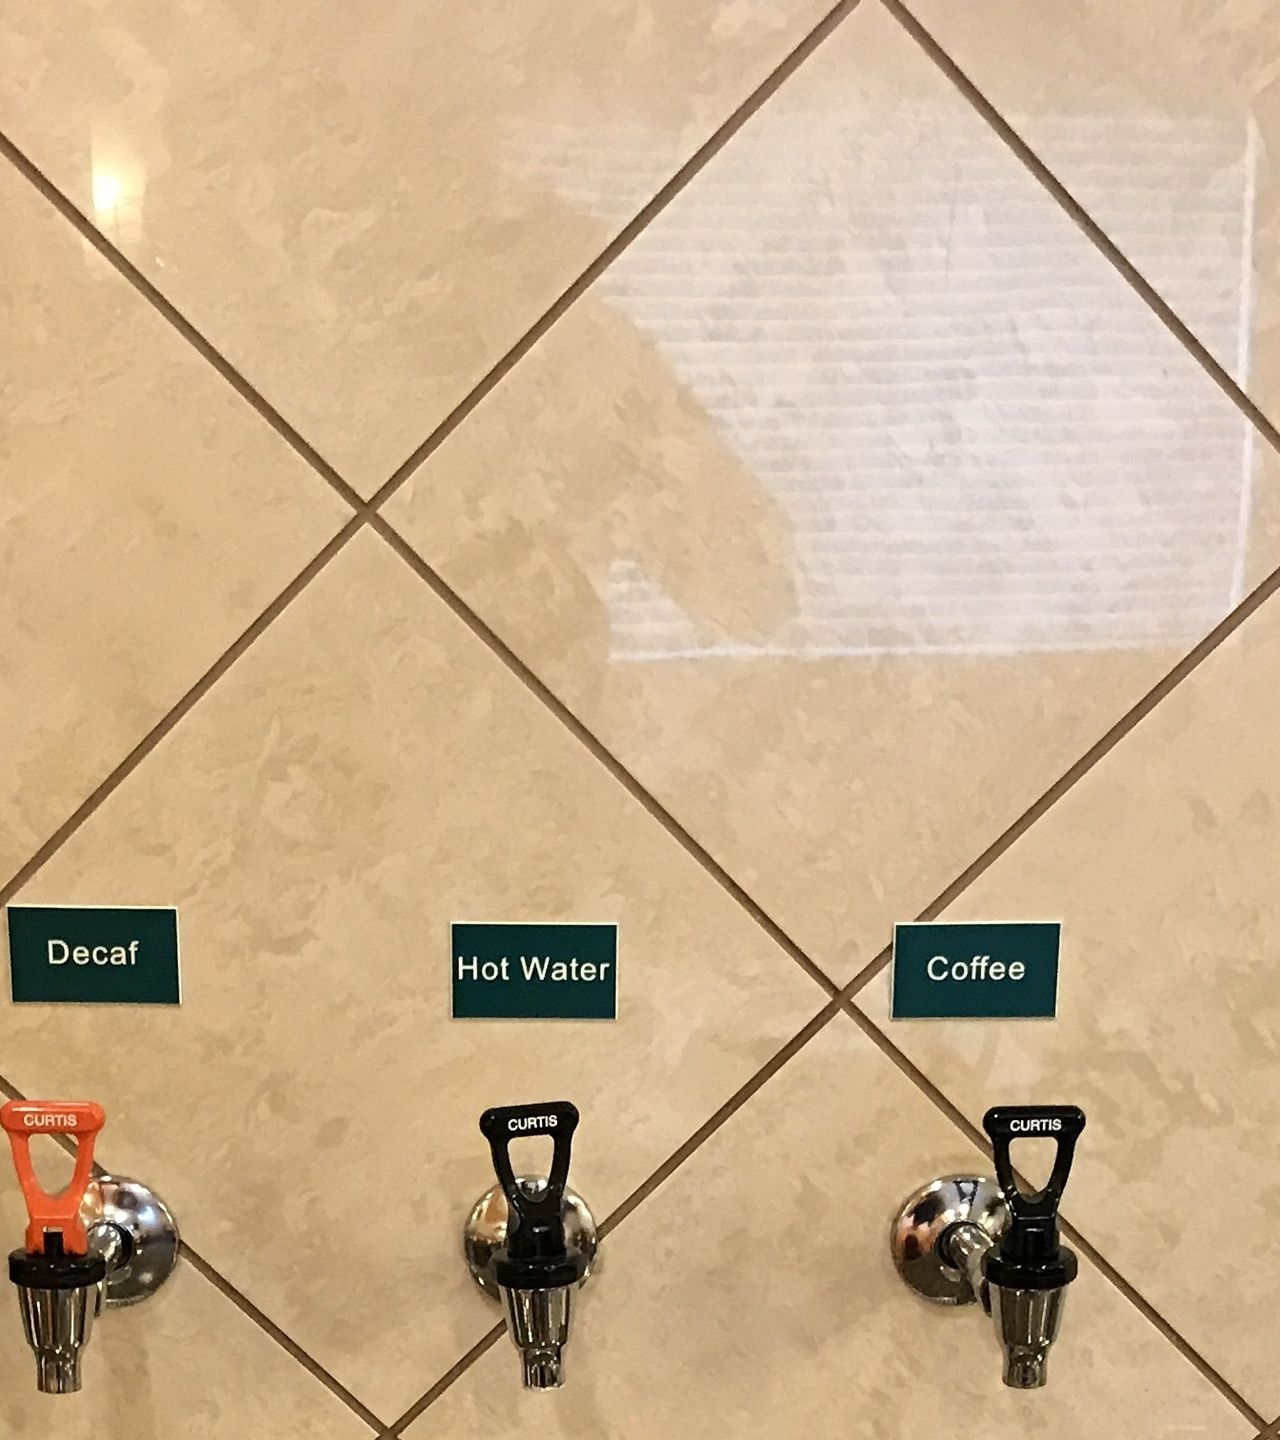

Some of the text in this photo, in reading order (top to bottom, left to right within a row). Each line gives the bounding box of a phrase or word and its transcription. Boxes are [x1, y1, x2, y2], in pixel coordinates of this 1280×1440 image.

[46, 939, 140, 966] Decaf
[457, 955, 611, 982] Hot Water
[926, 955, 1026, 982] Coffee
[22, 1113, 78, 1128] CURTIS
[507, 1114, 559, 1132] CURTIS
[1009, 1118, 1063, 1132] CURTIS
